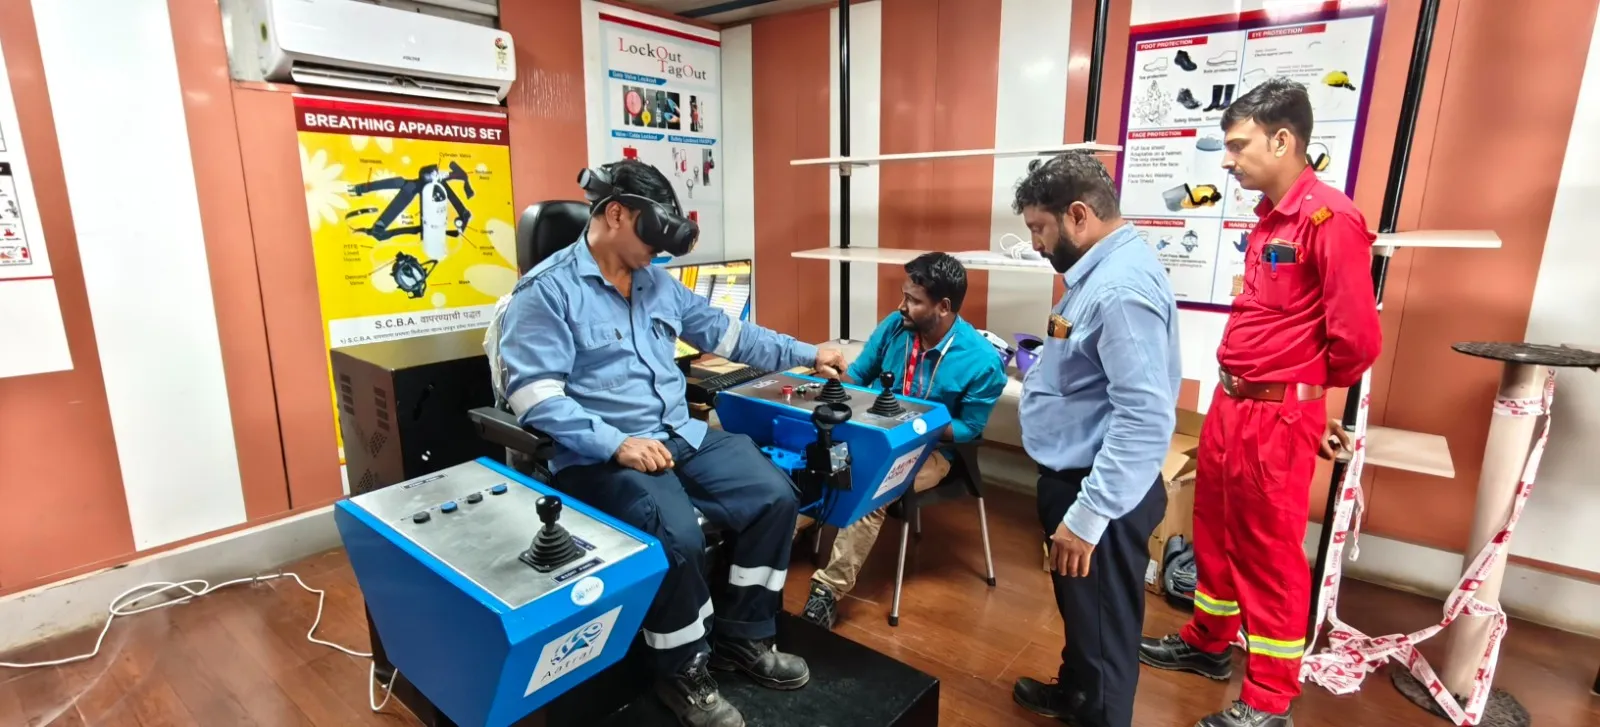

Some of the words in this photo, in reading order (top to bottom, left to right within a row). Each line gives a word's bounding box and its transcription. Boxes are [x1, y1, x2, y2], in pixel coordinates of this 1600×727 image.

[1263, 27, 1303, 36] PROTECTION
[618, 37, 682, 63] LockOut
[1156, 39, 1193, 48] PROTECTION
[657, 59, 706, 80] TagOut
[304, 112, 395, 132] BREATHING
[399, 120, 476, 139] APPARATUS
[480, 127, 502, 140] SET
[374, 317, 418, 330] S.C.B.A.
